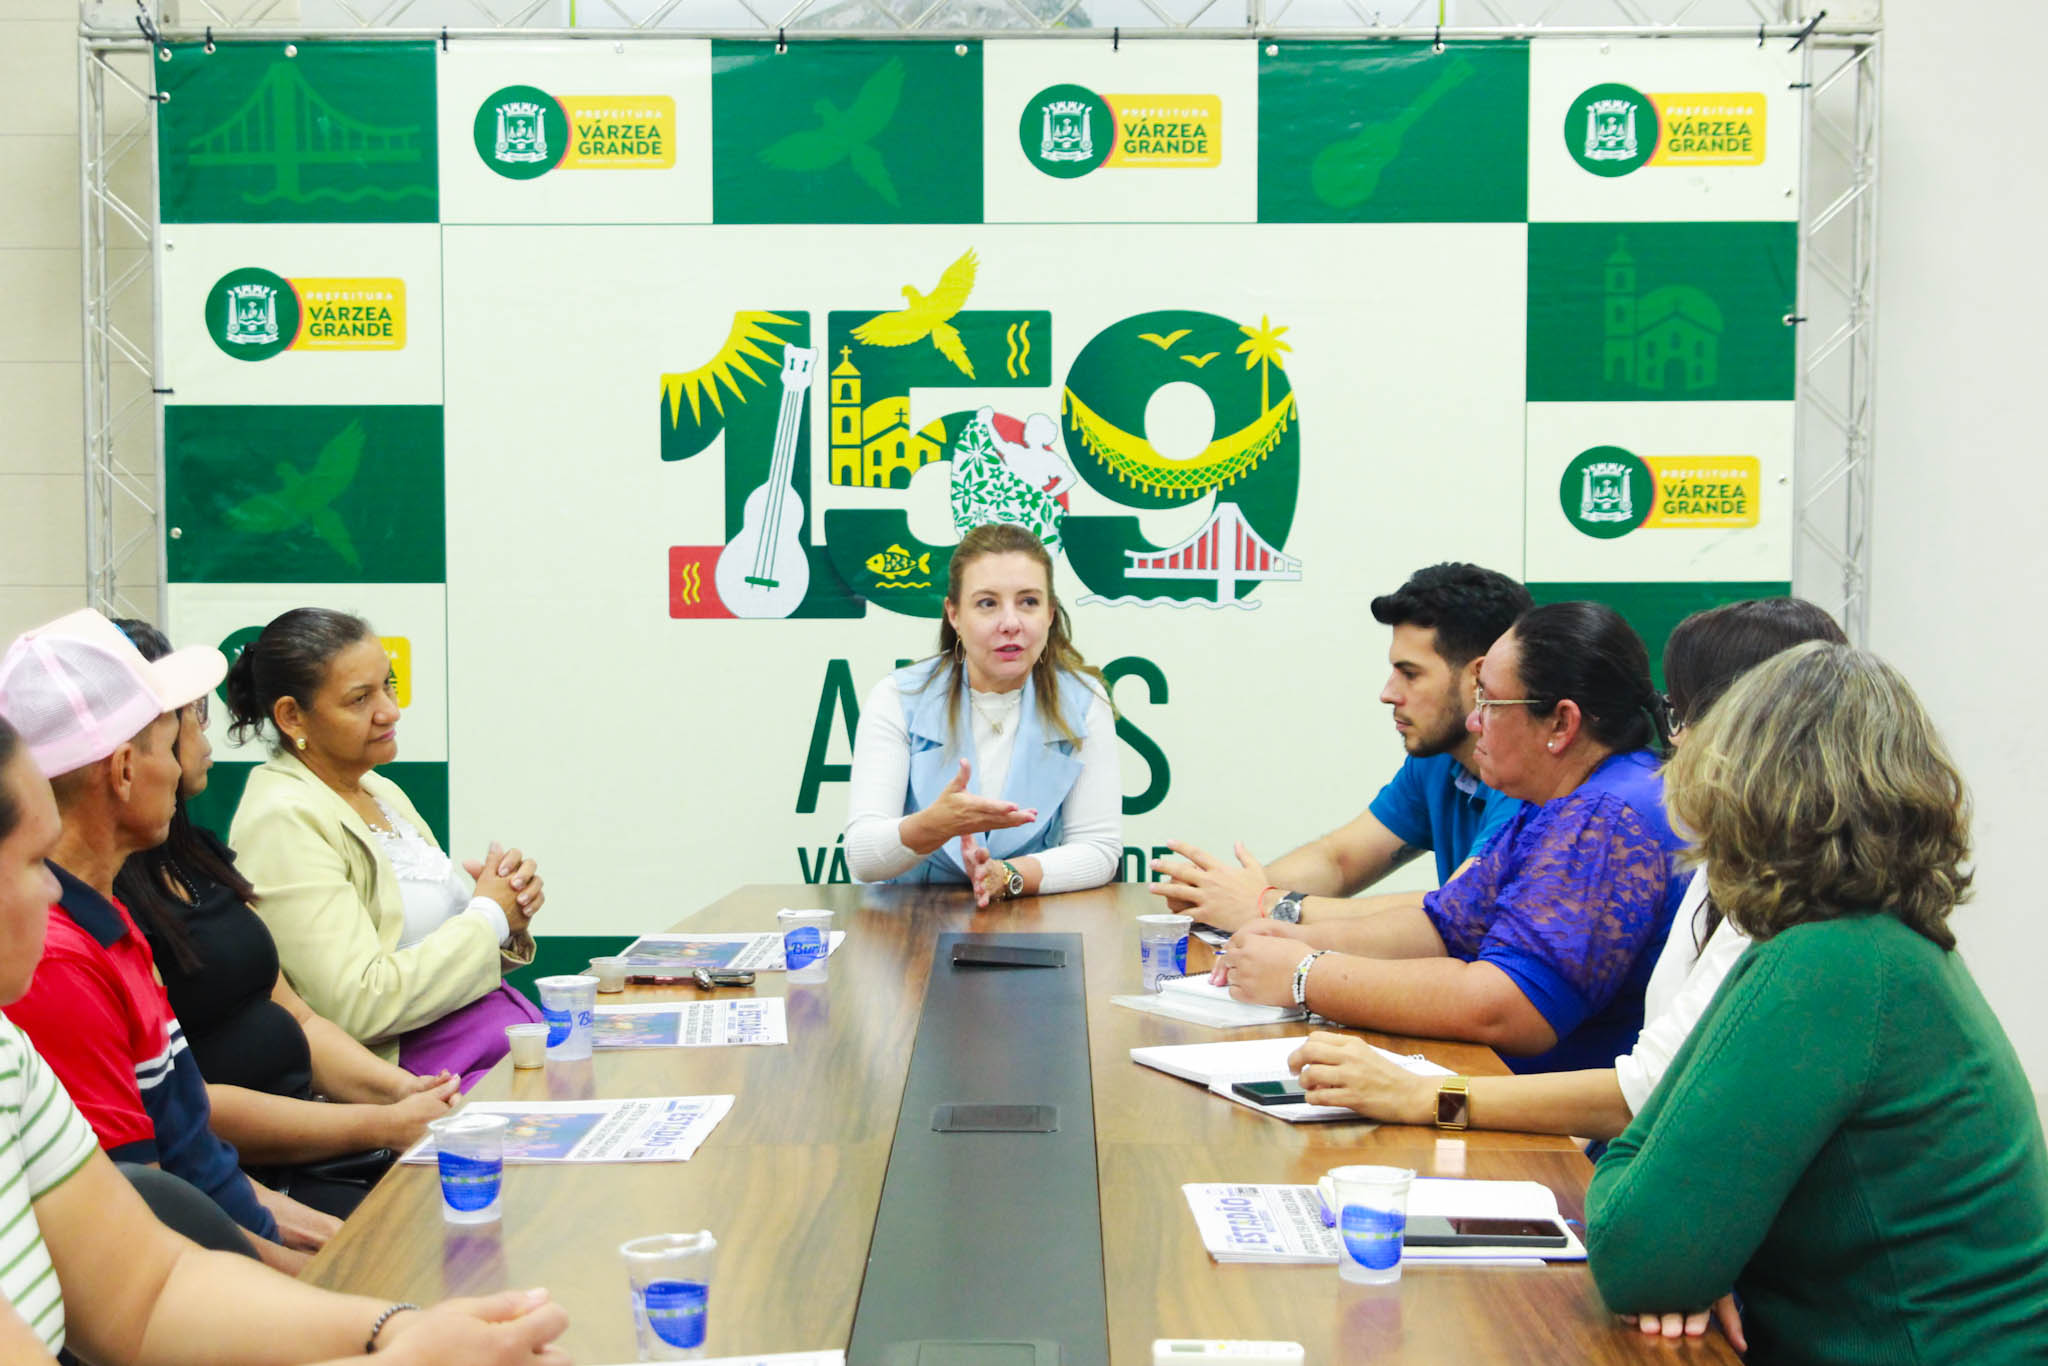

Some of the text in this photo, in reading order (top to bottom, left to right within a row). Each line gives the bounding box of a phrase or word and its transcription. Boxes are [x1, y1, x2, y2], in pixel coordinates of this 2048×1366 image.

[575, 109, 663, 118] PREFEITURA
[1121, 108, 1208, 117] PREFEITURA
[1666, 106, 1753, 116] PREFEITURA
[578, 120, 661, 139] VÁRZEA
[1124, 119, 1207, 138] VÁRZEA
[1669, 118, 1752, 136] VÁRZEA
[578, 141, 663, 155] GRANDE
[1123, 140, 1208, 153] GRANDE
[1668, 138, 1752, 152] GRANDE
[306, 292, 393, 300] PREFEITURA
[309, 302, 392, 321] VÁRZEA
[309, 323, 393, 336] GRANDE
[660, 310, 1302, 620] 159
[1661, 469, 1748, 478] PREFEITURA
[1663, 480, 1746, 498] VÁRZEA
[1663, 501, 1747, 514] GRANDE
[796, 656, 1171, 816] AS
[1216, 1197, 1268, 1244] ESTADÃO
